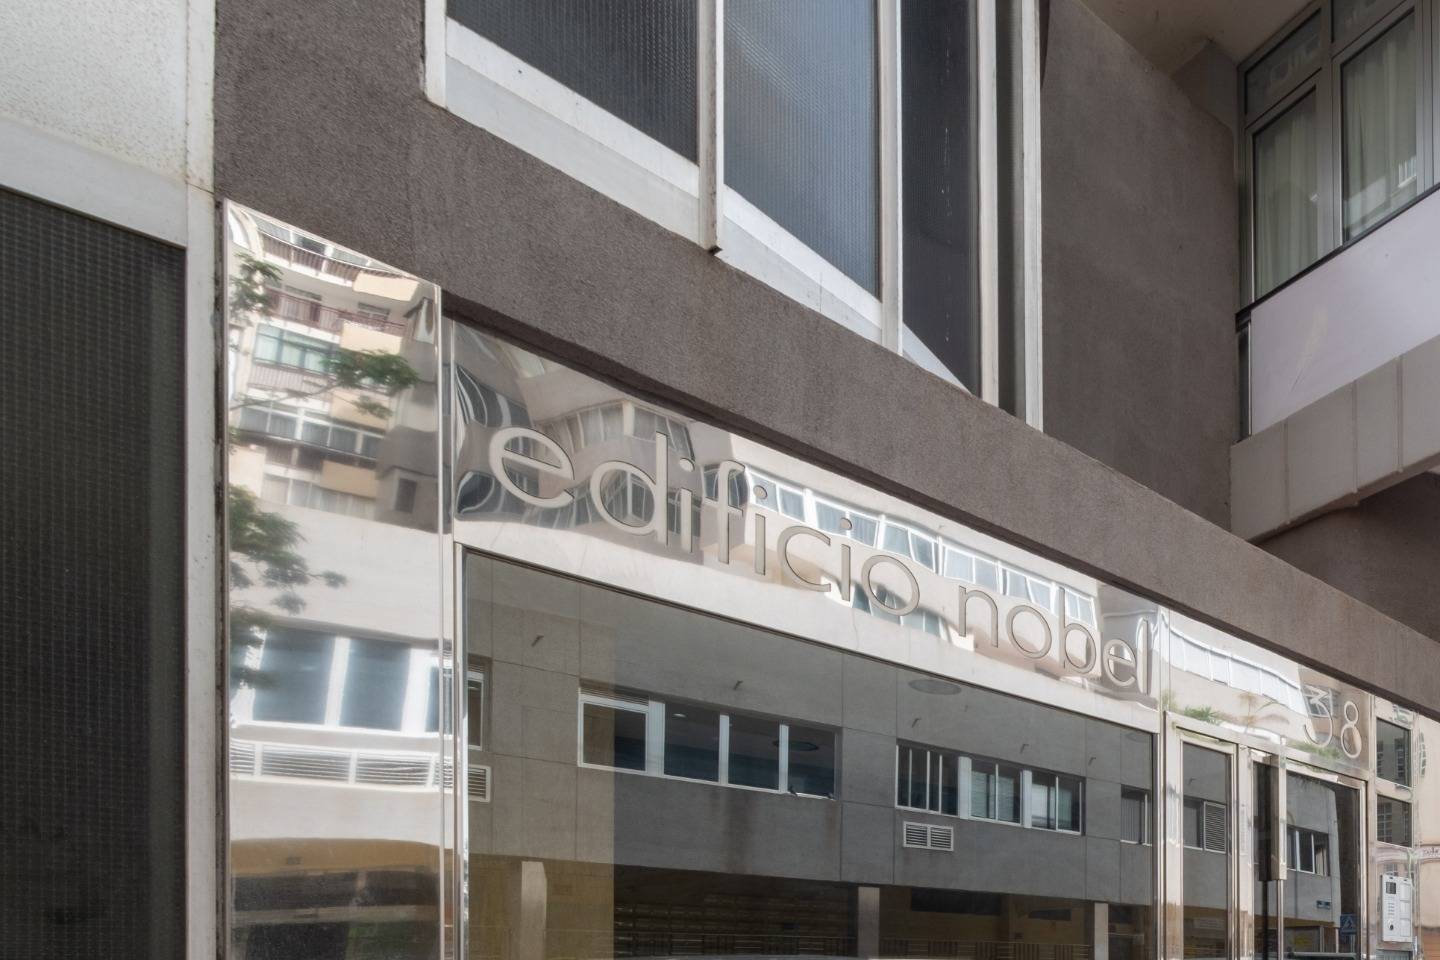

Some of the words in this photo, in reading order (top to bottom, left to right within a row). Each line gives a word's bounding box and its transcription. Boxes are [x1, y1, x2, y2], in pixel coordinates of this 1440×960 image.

[489, 427, 919, 616] edificio
[958, 585, 1150, 697] nobel
[1303, 690, 1362, 758] 38
